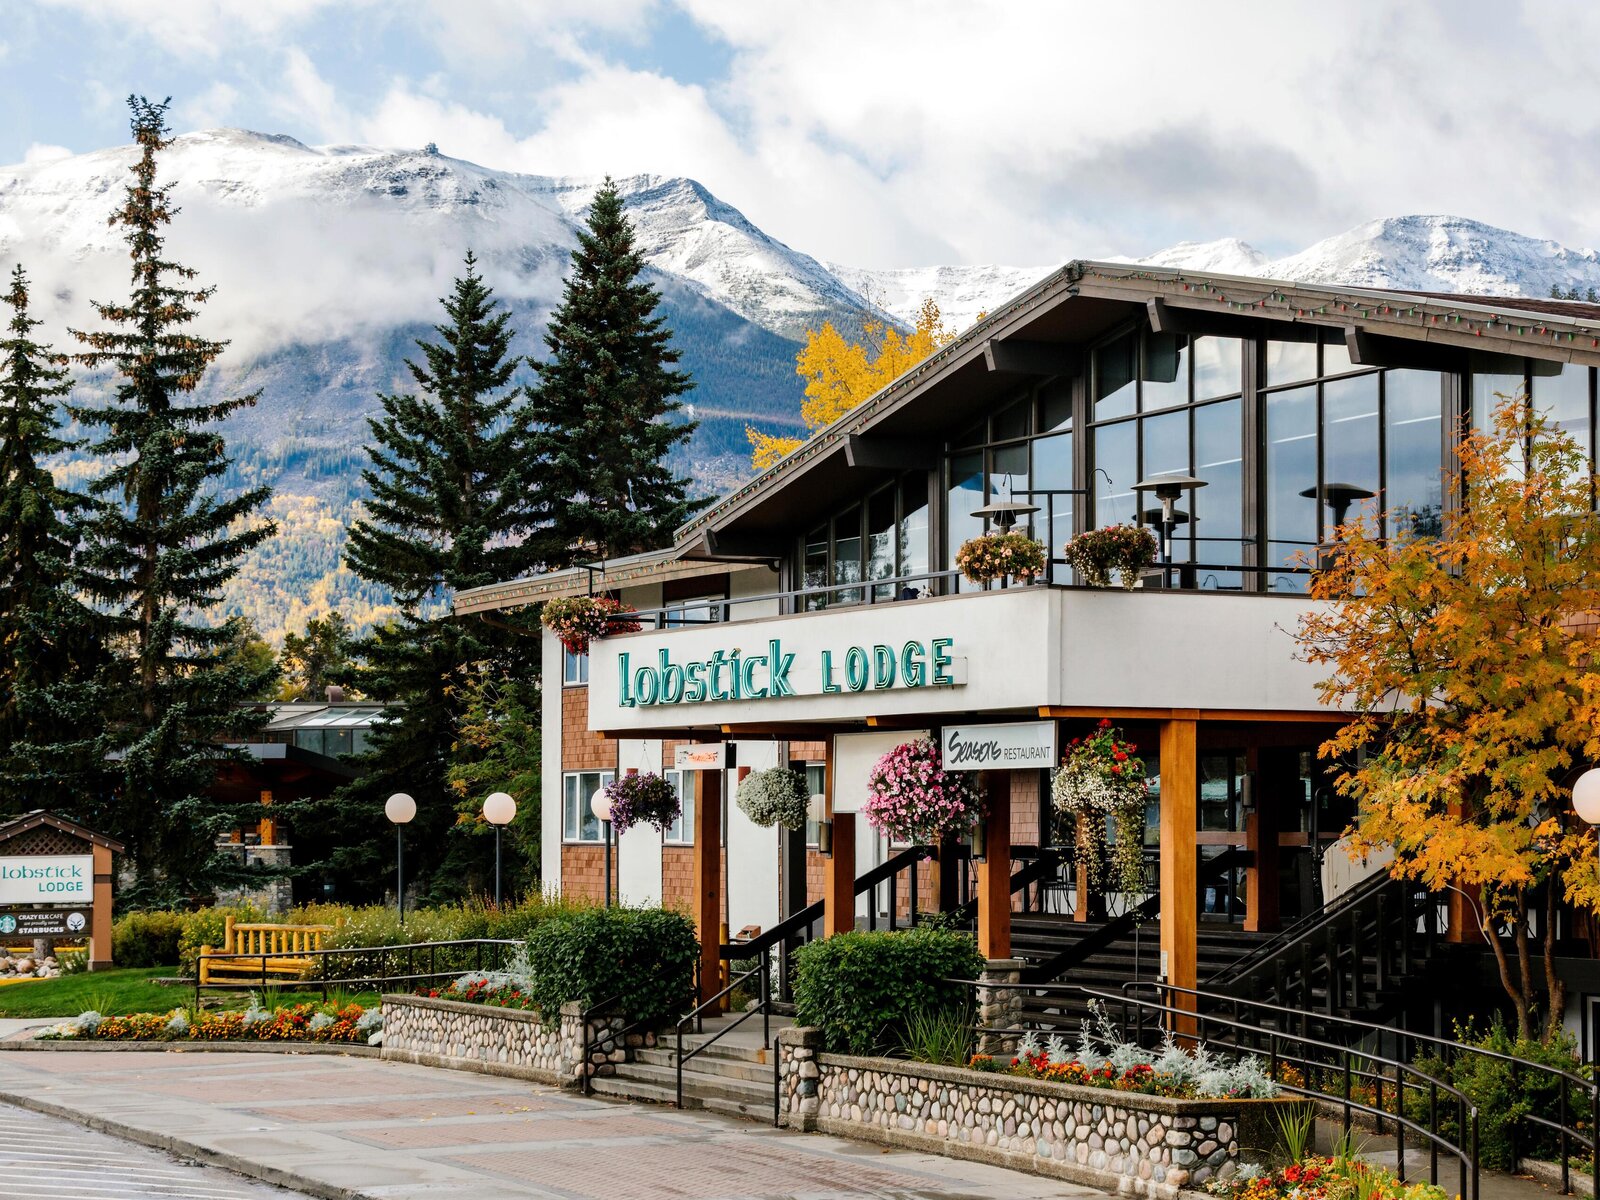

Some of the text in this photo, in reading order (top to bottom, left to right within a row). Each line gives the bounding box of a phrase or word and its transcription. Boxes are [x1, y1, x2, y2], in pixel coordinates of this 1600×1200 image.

[821, 637, 954, 693] LODGE
[948, 731, 1051, 764] Seasons RESTAURANT
[38, 881, 83, 892] LODGE
[18, 926, 65, 934] STARBUCKS
